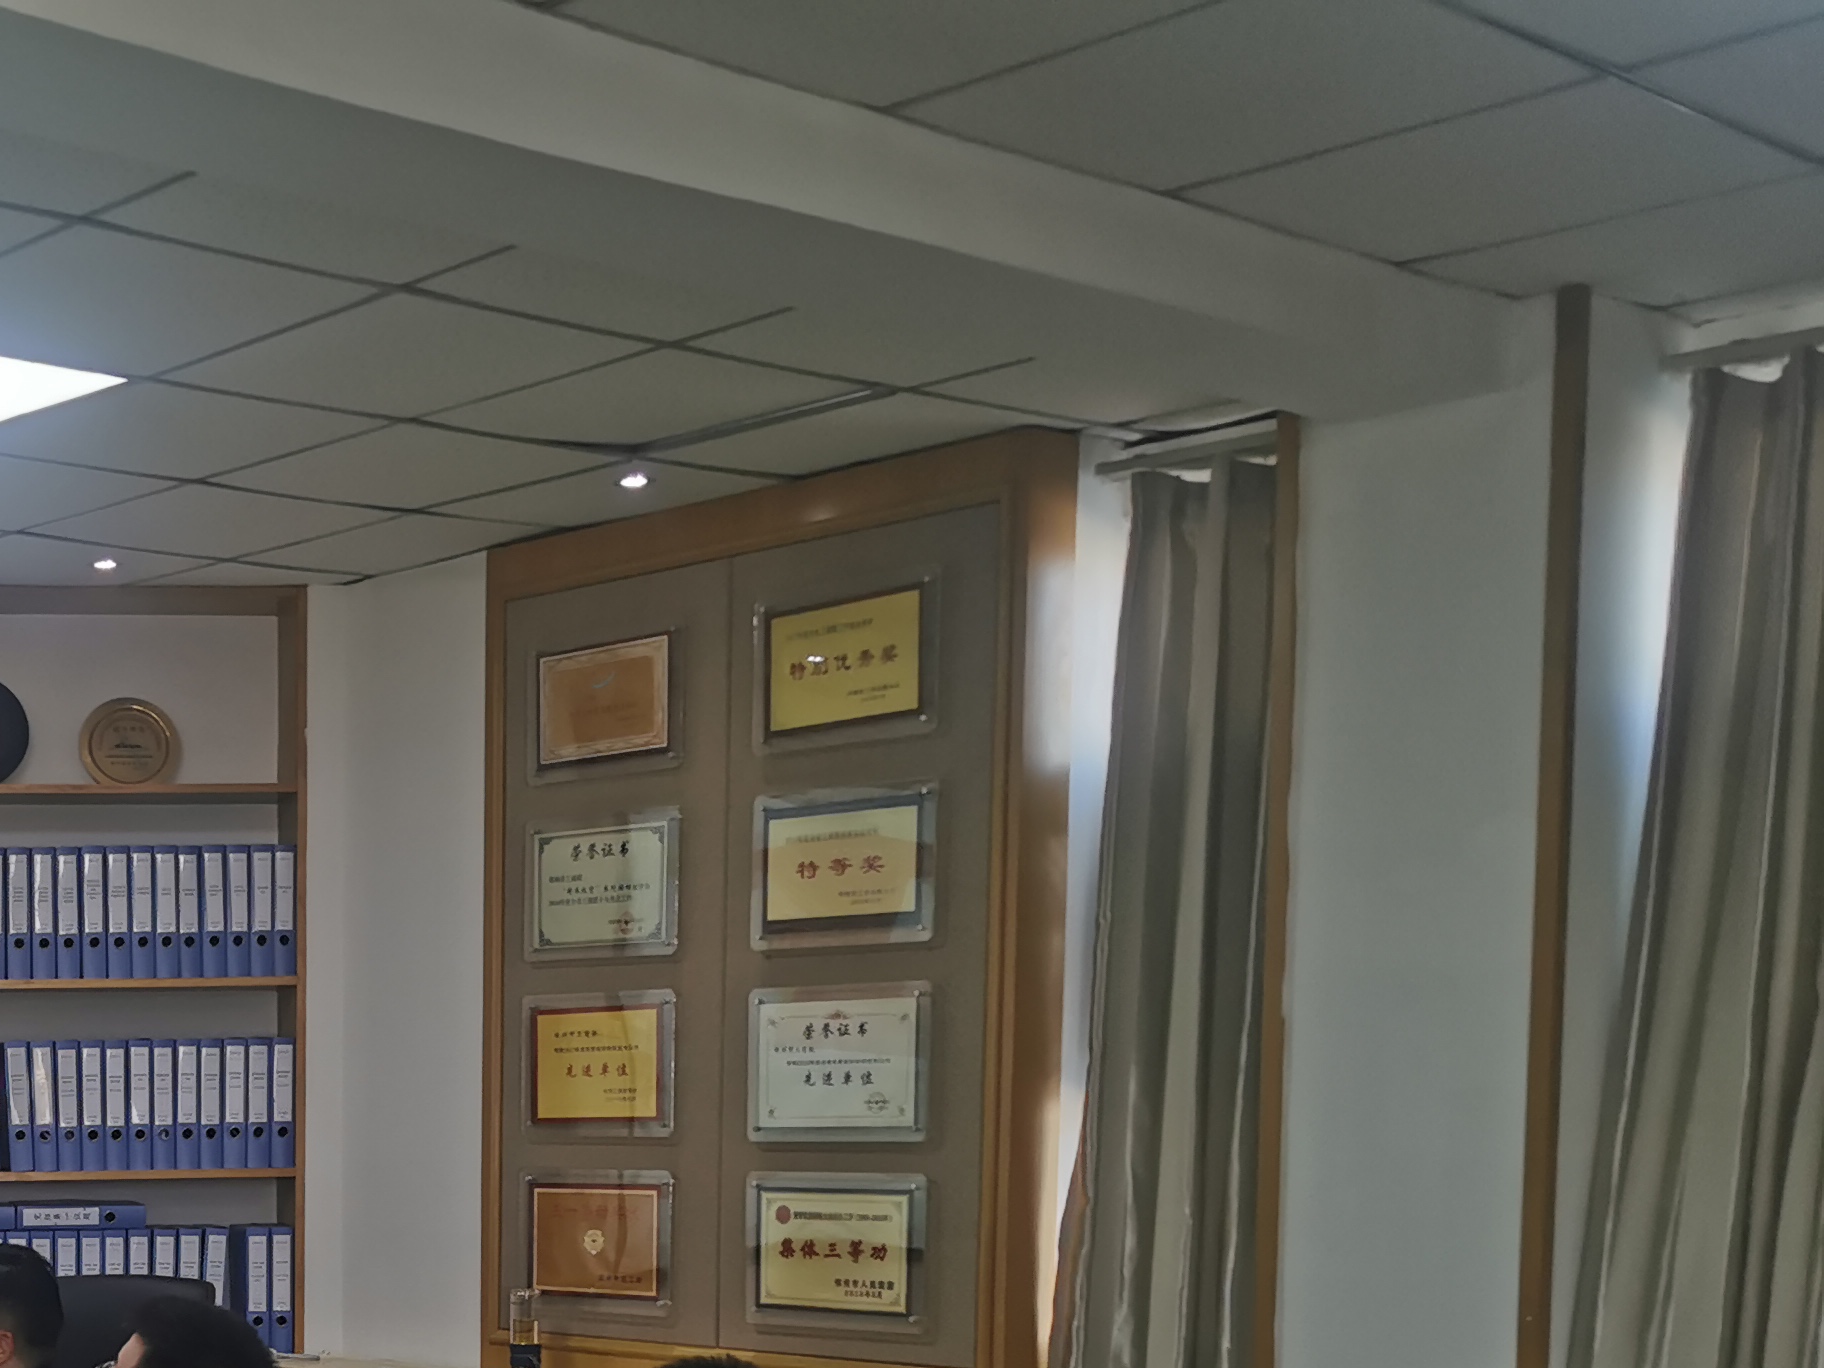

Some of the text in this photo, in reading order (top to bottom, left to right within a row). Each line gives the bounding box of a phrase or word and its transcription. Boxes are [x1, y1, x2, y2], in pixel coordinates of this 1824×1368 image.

[795, 854, 885, 880] 特等奖
[778, 1237, 889, 1263] 集体三等功
